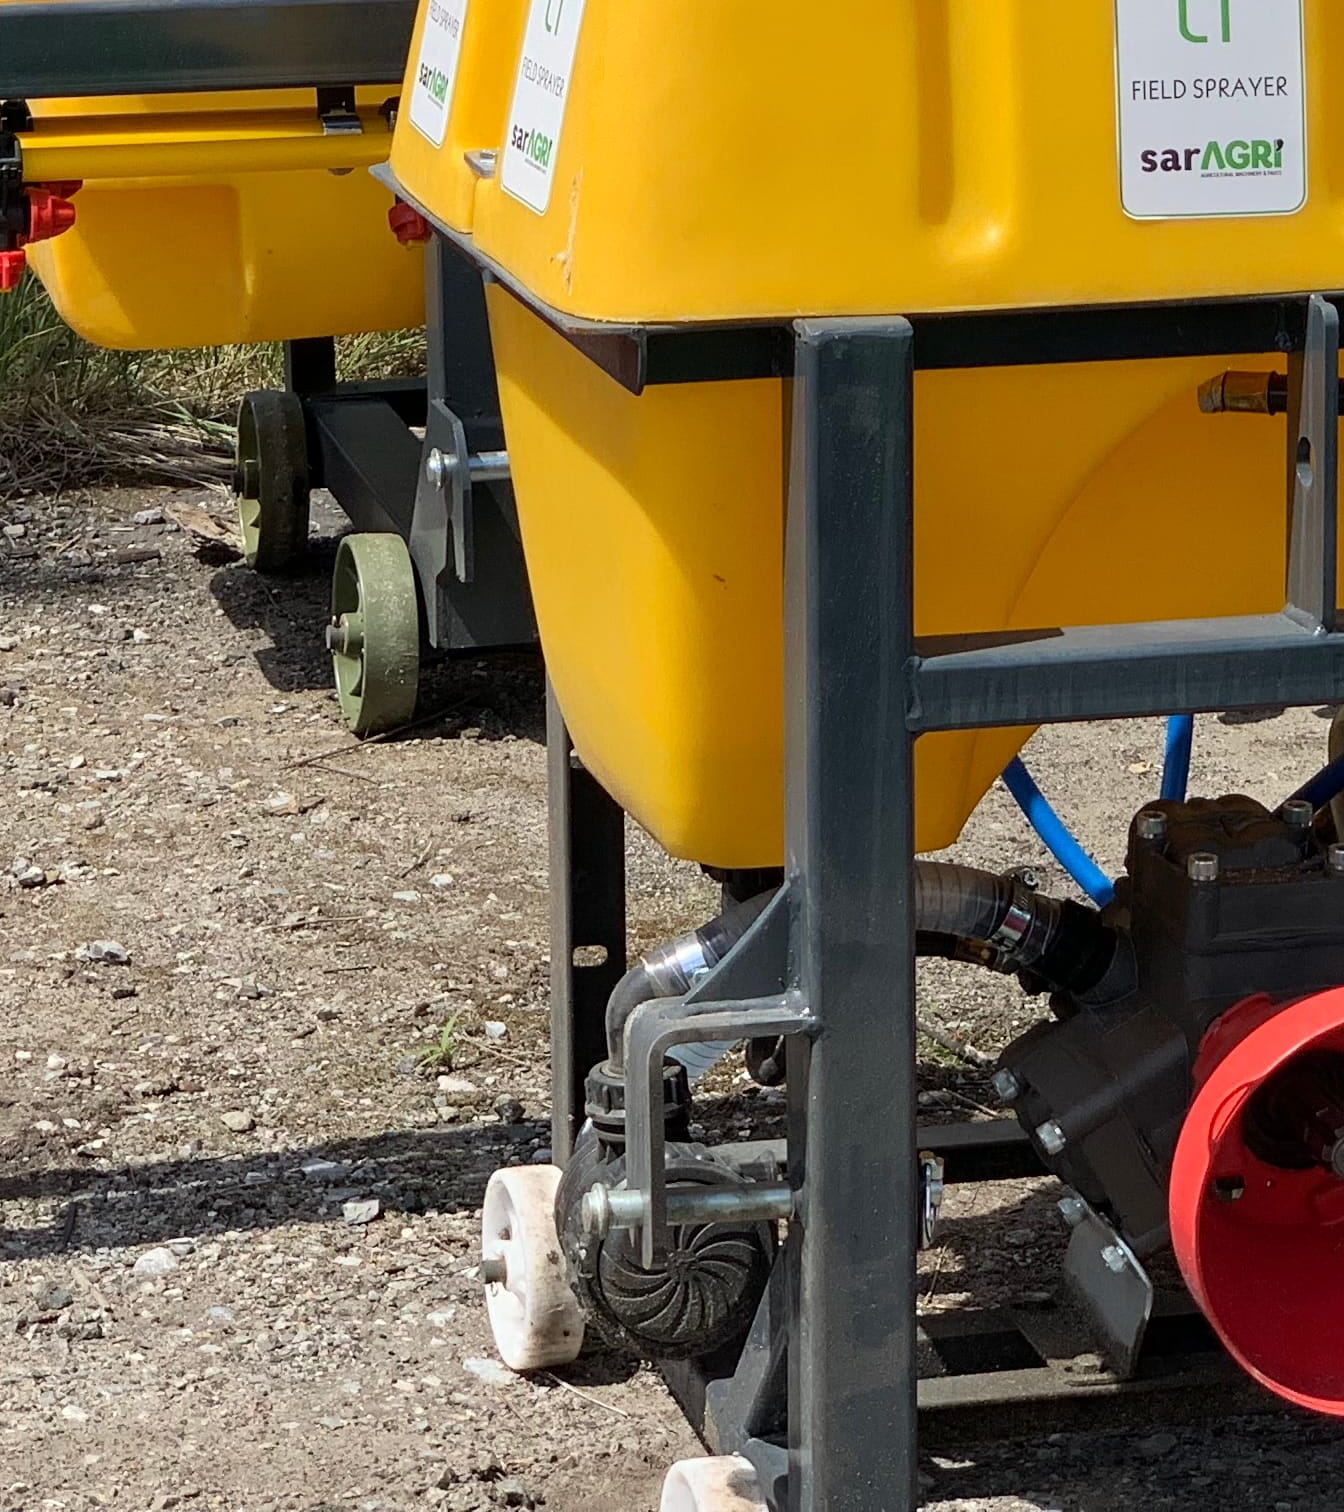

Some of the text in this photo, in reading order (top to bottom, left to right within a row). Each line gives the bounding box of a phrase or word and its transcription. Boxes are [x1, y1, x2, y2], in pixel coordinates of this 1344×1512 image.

[522, 55, 565, 97] FIELD SPRAYER
[1132, 75, 1289, 100] FIELD SPRAYER
